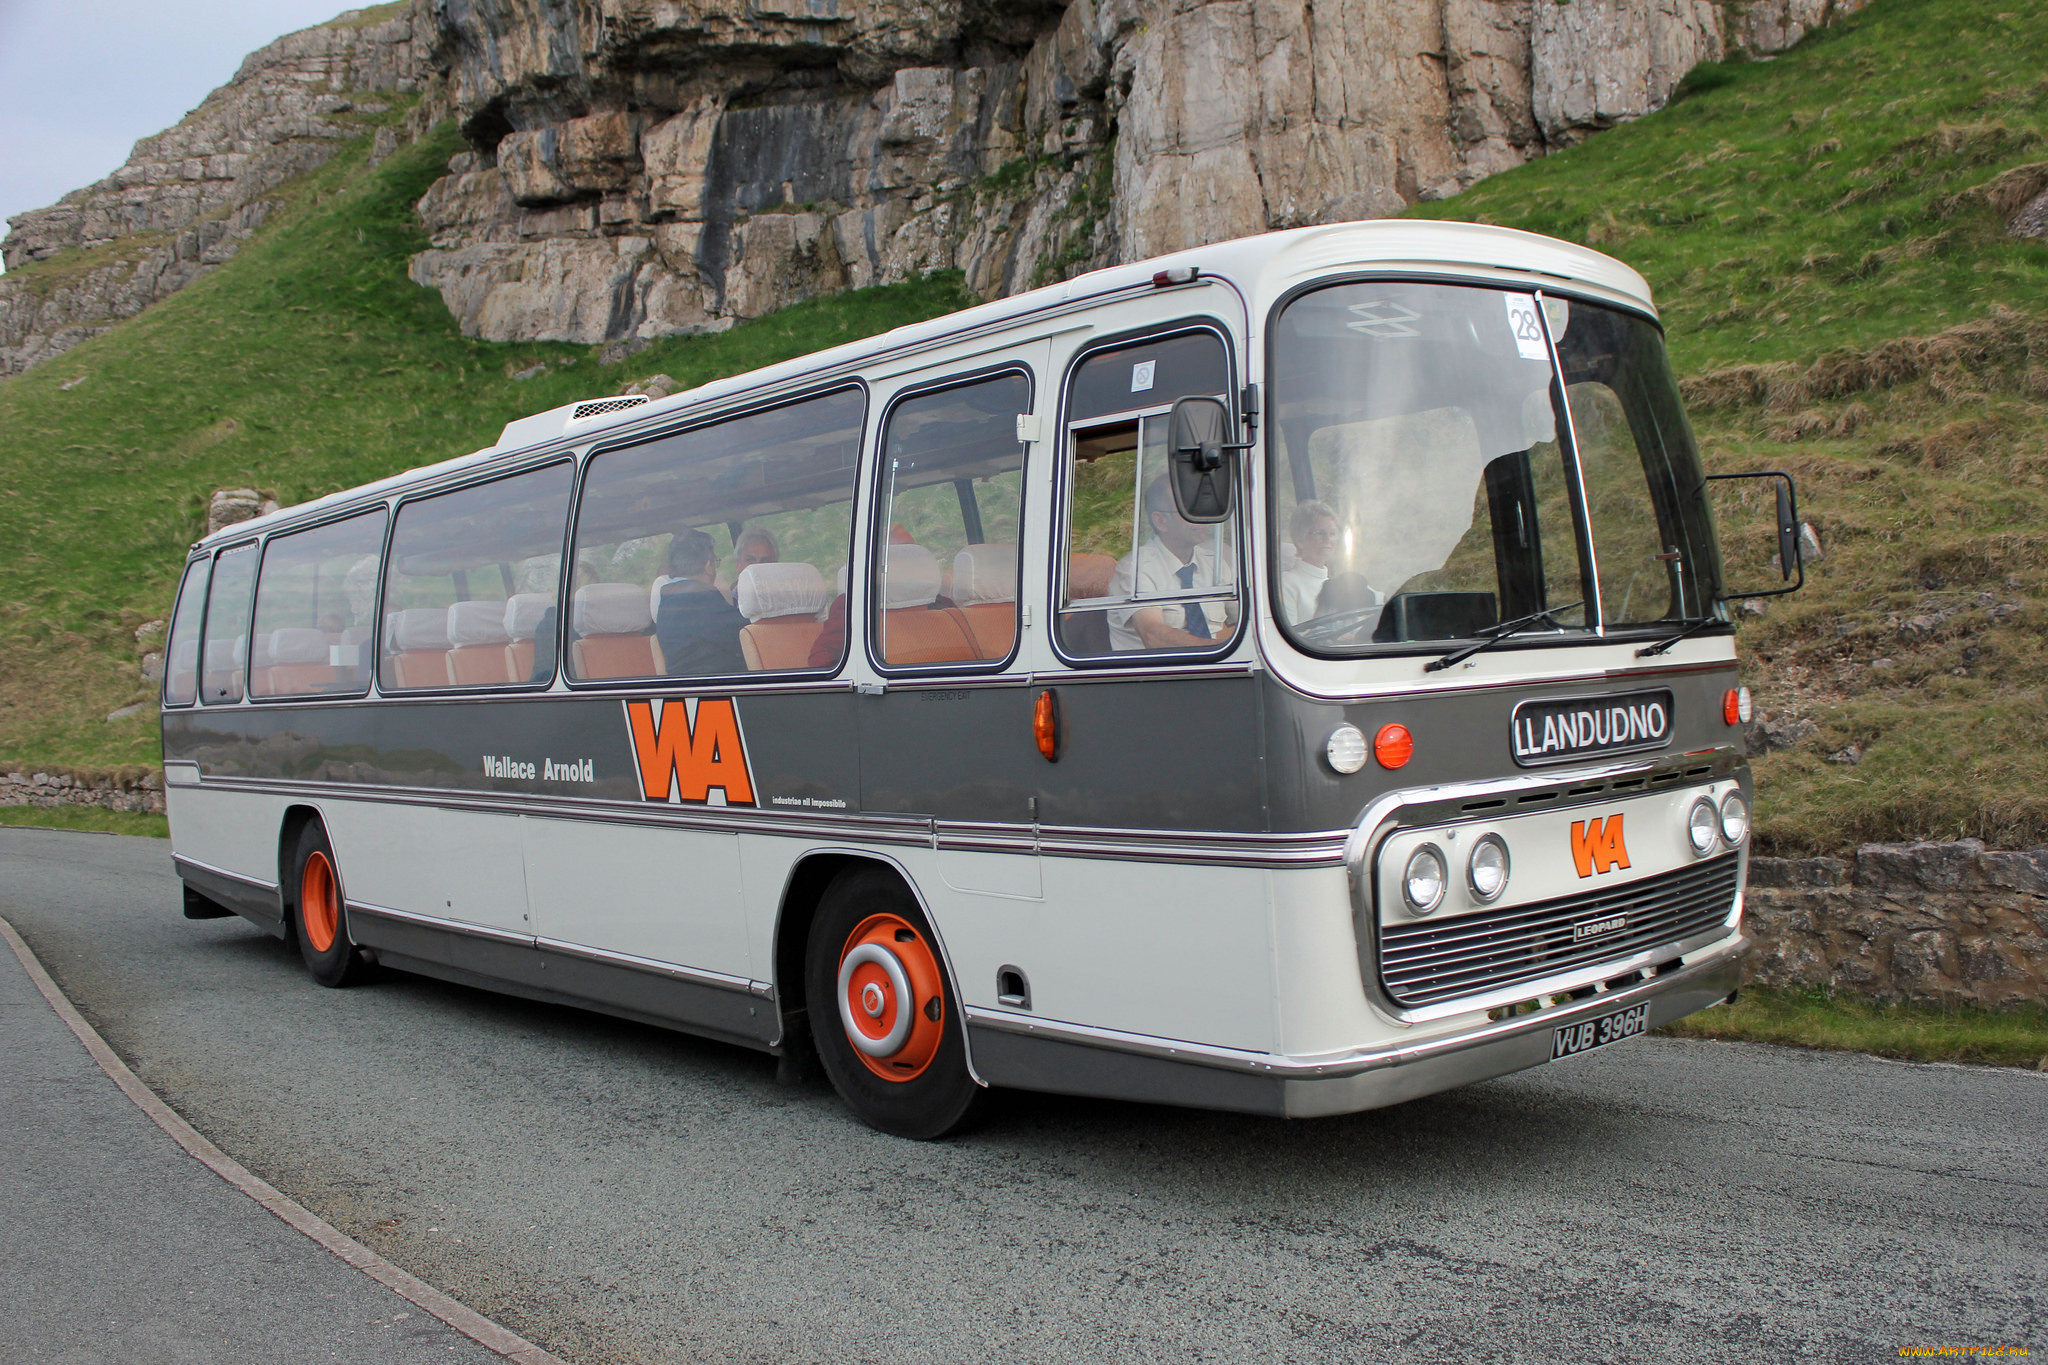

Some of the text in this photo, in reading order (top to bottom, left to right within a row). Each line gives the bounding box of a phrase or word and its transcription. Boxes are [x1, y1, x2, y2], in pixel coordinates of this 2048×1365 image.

[1511, 308, 1541, 341] 28
[1514, 702, 1666, 756] LLANDUDNO
[483, 755, 594, 783] Wallace Arnold
[623, 697, 759, 807] WA
[772, 796, 801, 805] industriae
[802, 797, 811, 806] nil
[1570, 813, 1632, 879] WA
[1577, 917, 1626, 938] LEOPARD
[1556, 1004, 1648, 1057] VUB 396H
